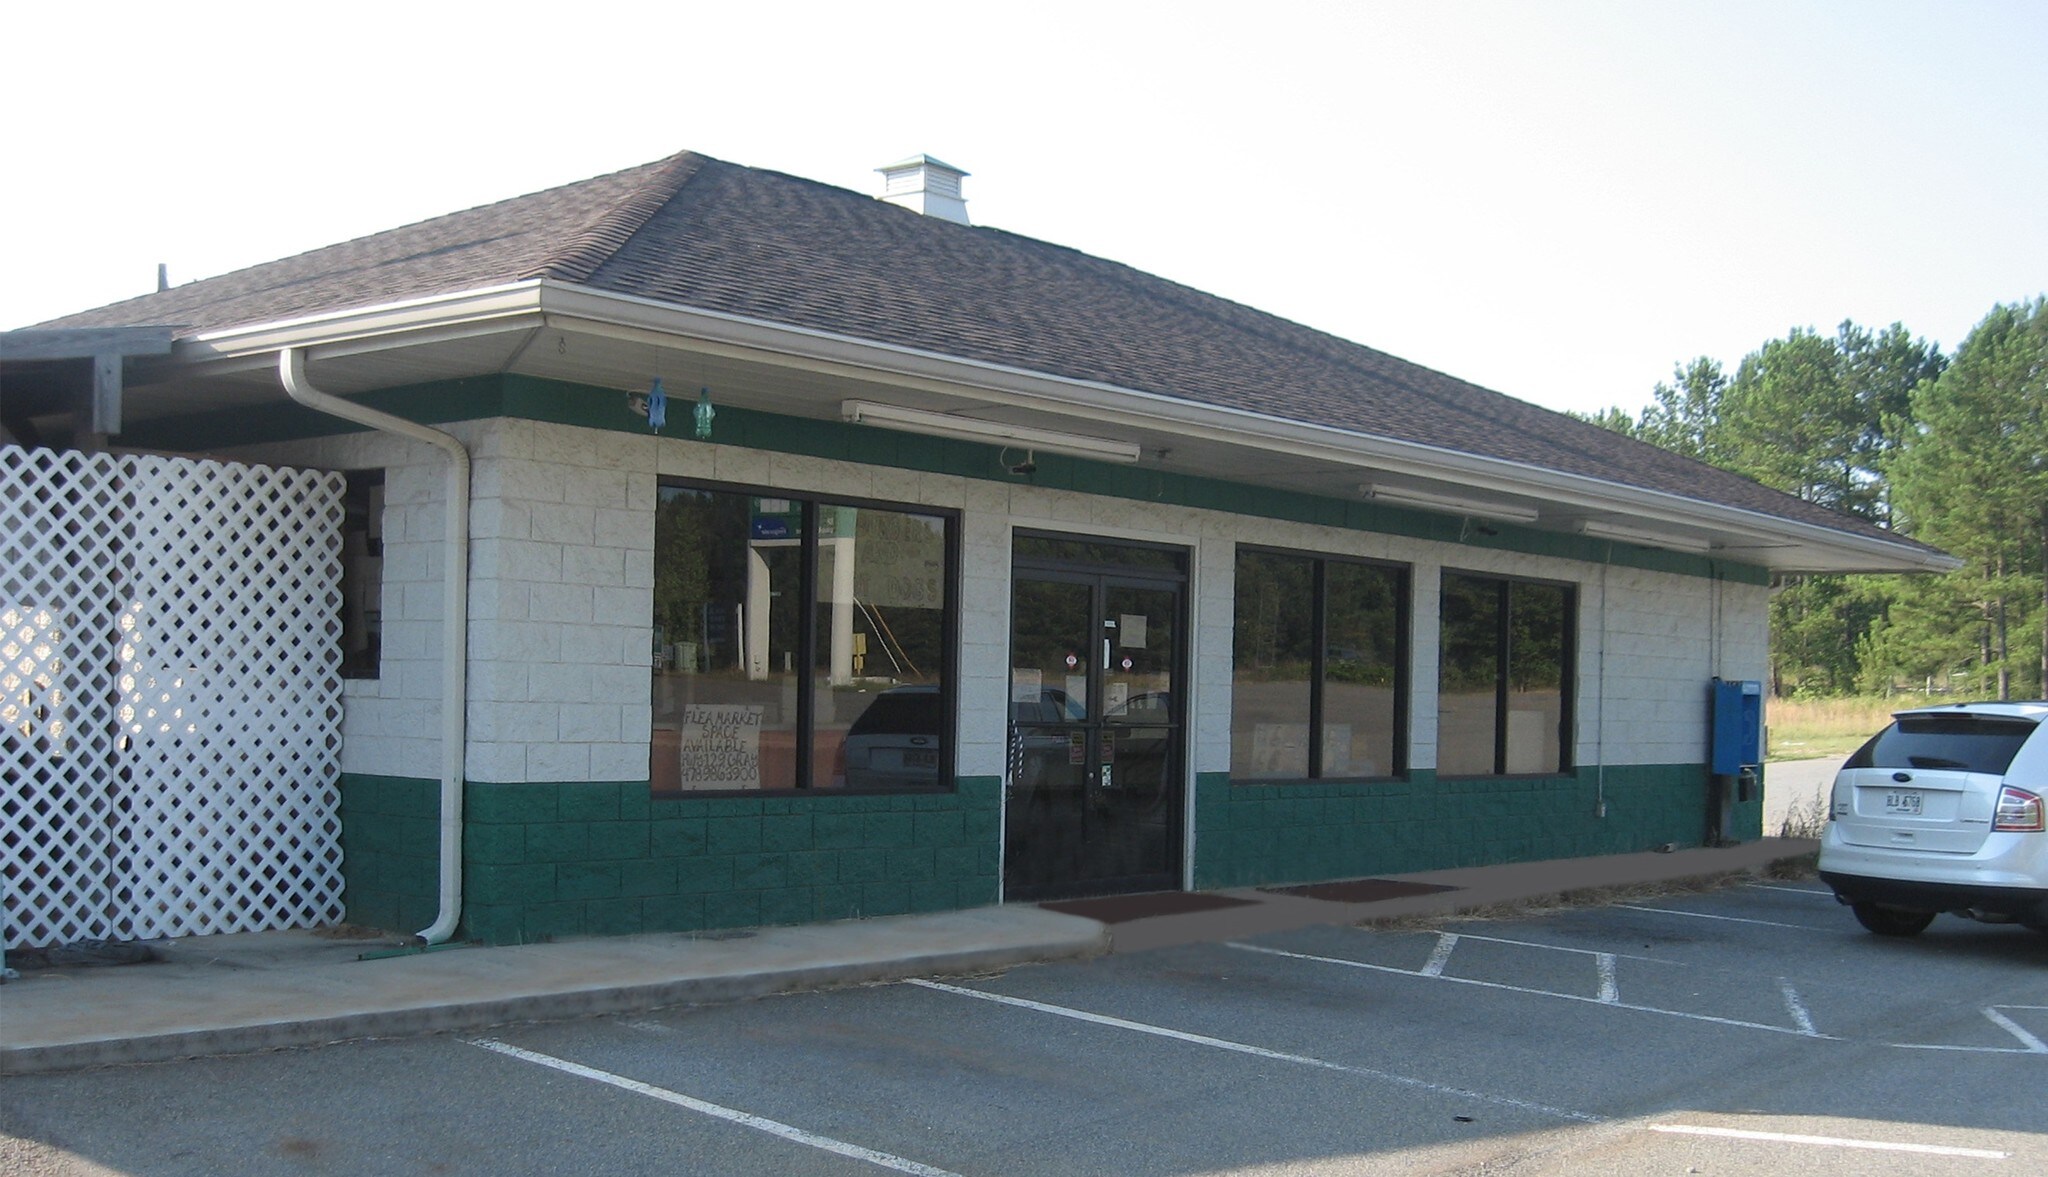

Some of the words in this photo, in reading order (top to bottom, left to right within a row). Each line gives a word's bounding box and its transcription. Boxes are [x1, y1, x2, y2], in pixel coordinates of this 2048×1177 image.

[684, 711, 713, 725] FLEA
[716, 711, 762, 726] MARKET
[702, 725, 740, 739] SPACE
[683, 739, 747, 754] AVAILABLE
